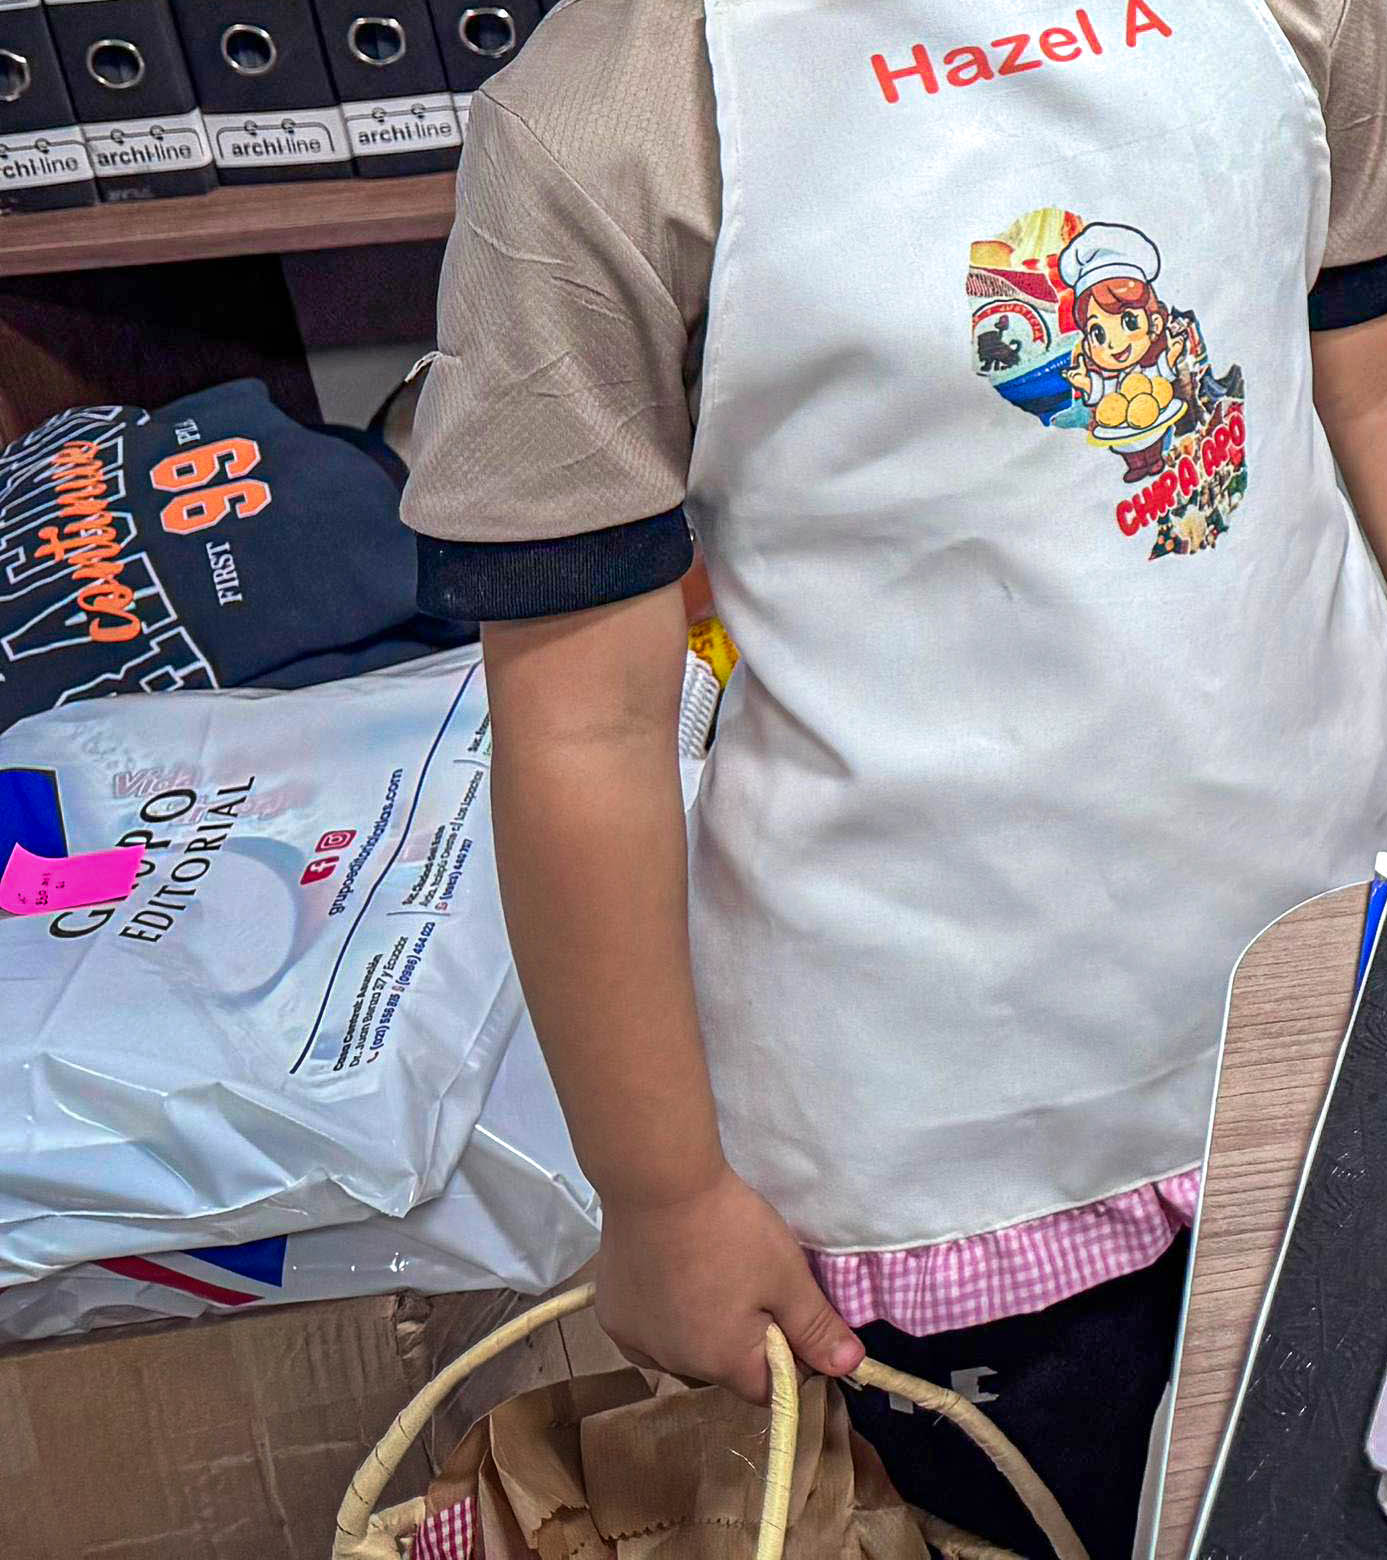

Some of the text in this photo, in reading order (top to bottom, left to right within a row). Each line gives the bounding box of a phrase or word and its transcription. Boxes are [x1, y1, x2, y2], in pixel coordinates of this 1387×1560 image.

[871, 9, 1103, 104] Hazel
[1116, 411, 1247, 538] CHIPA APO
[35, 441, 142, 641] continue
[205, 541, 243, 607] FIRST
[118, 776, 255, 942] EDITORIAL
